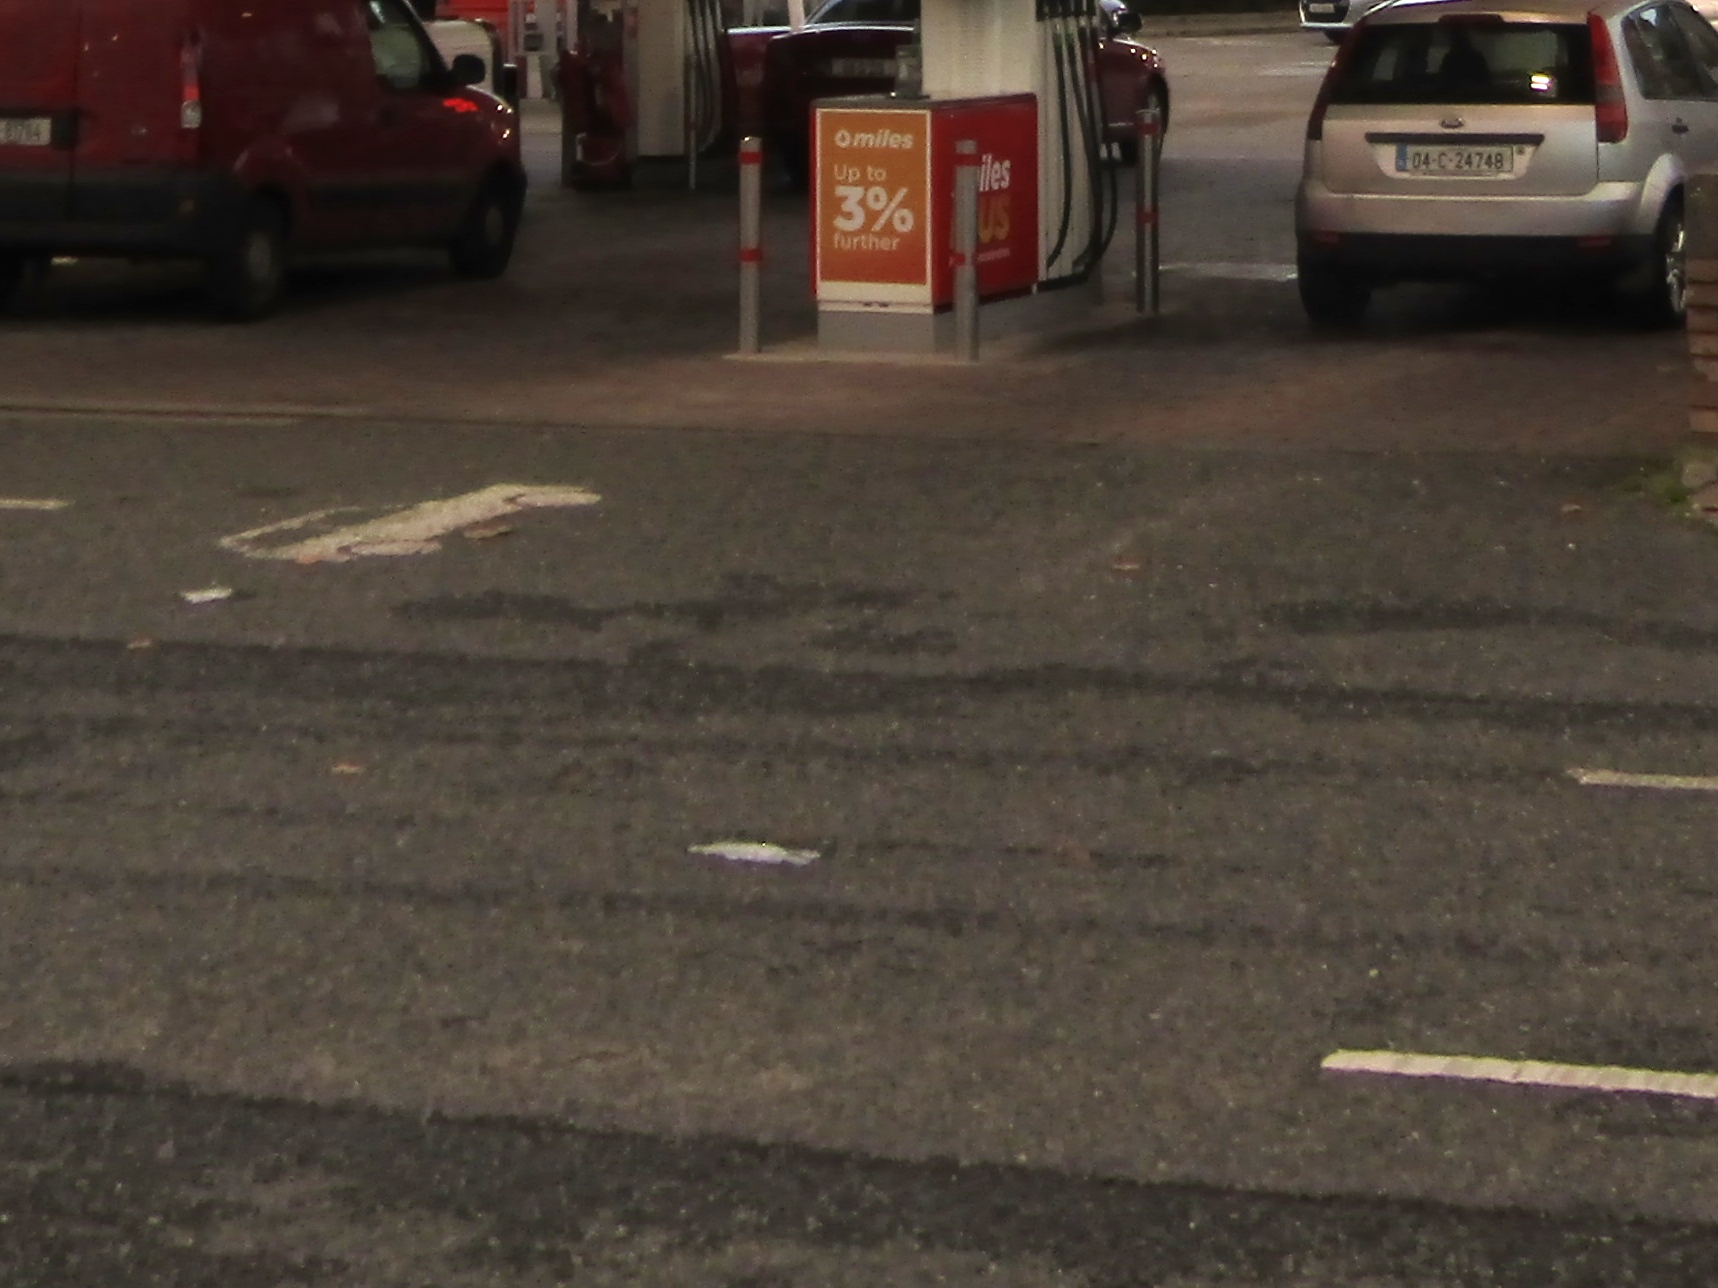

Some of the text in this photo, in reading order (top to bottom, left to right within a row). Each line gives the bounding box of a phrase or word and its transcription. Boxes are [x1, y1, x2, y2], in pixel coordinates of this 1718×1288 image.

[834, 164, 886, 184] Up to
[978, 153, 1012, 192] iles
[833, 185, 915, 233] 3%
[834, 233, 901, 251] further
